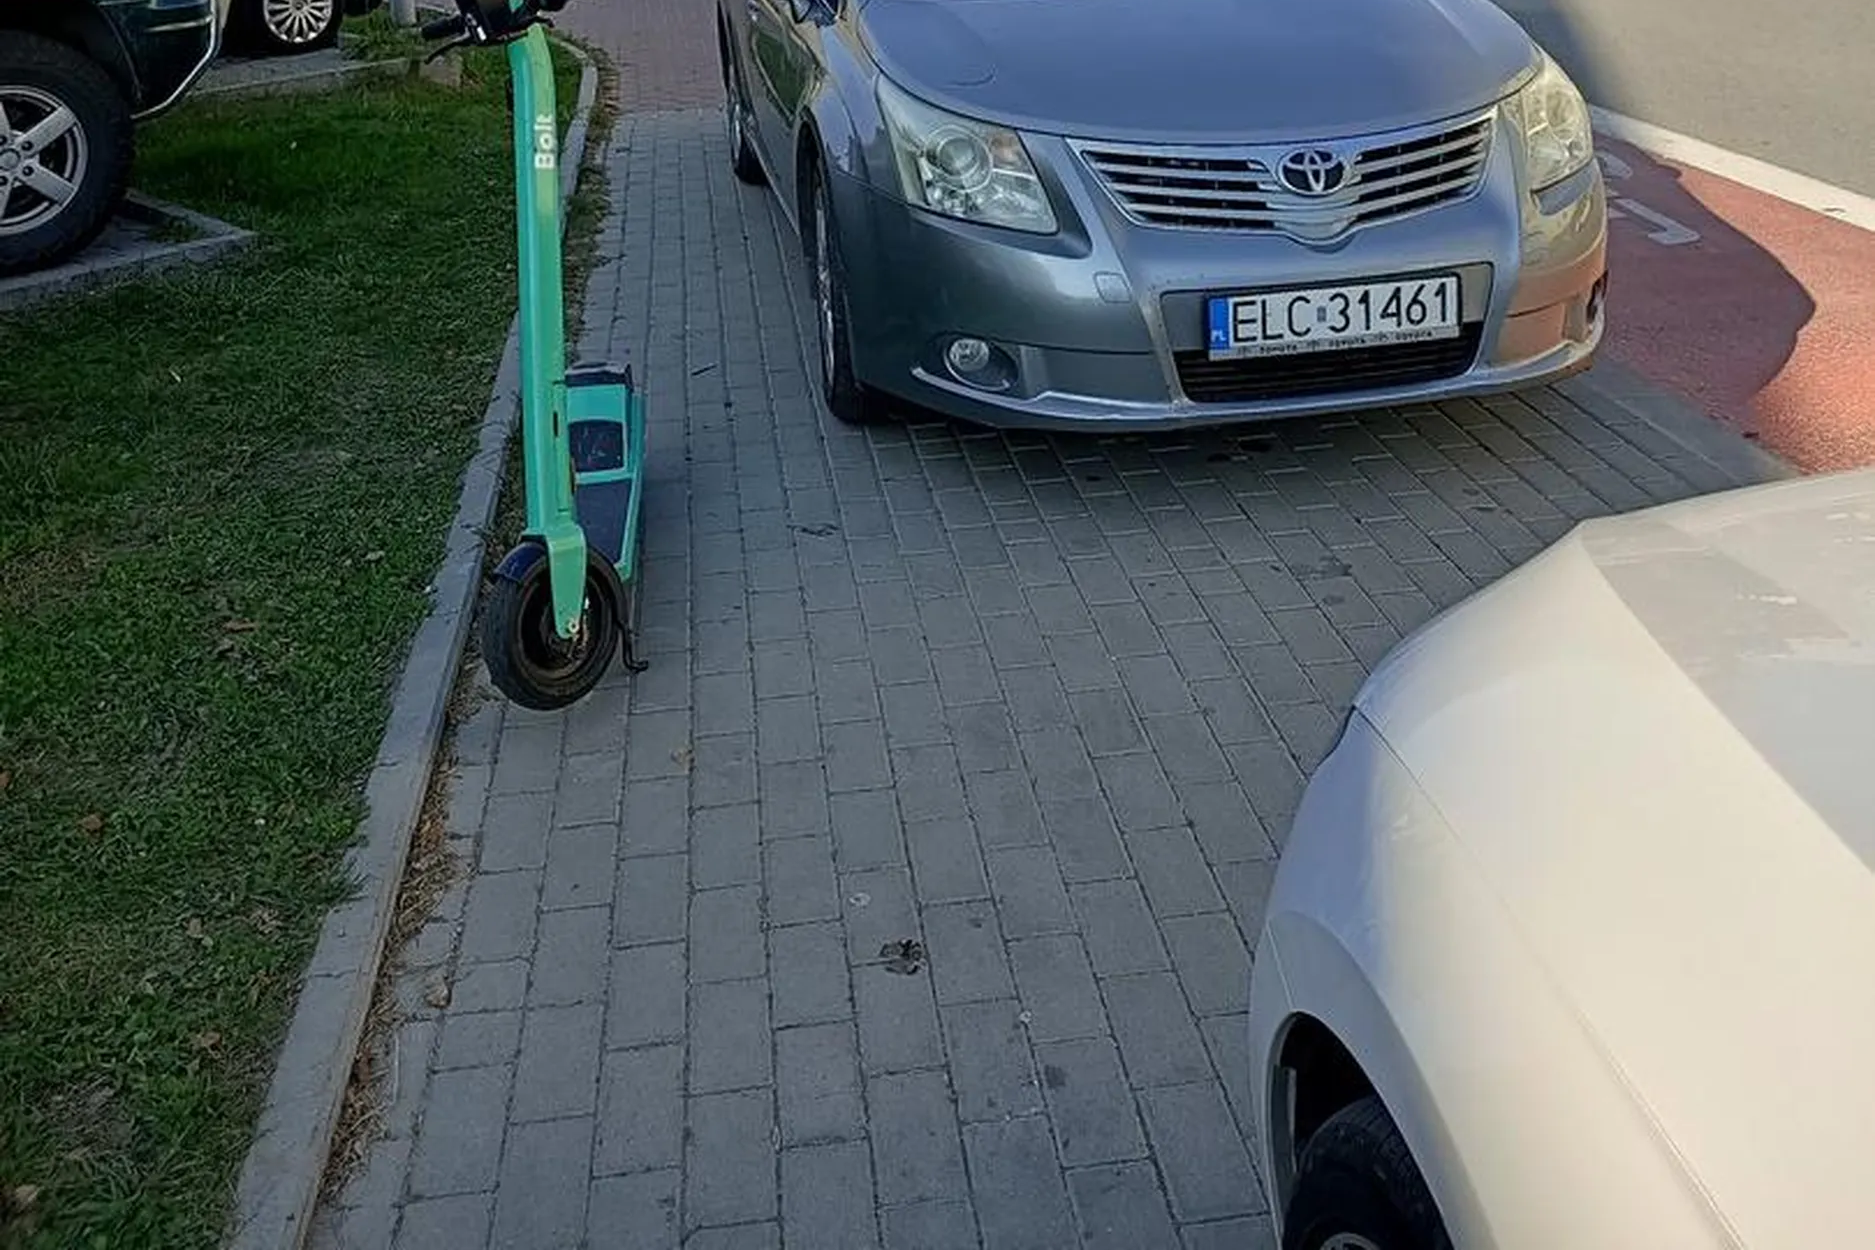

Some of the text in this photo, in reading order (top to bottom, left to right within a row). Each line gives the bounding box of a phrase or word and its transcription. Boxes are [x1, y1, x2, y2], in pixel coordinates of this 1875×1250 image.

[534, 114, 555, 169] Bolt
[1210, 329, 1227, 342] PL
[1232, 281, 1448, 343] ELC 31461
